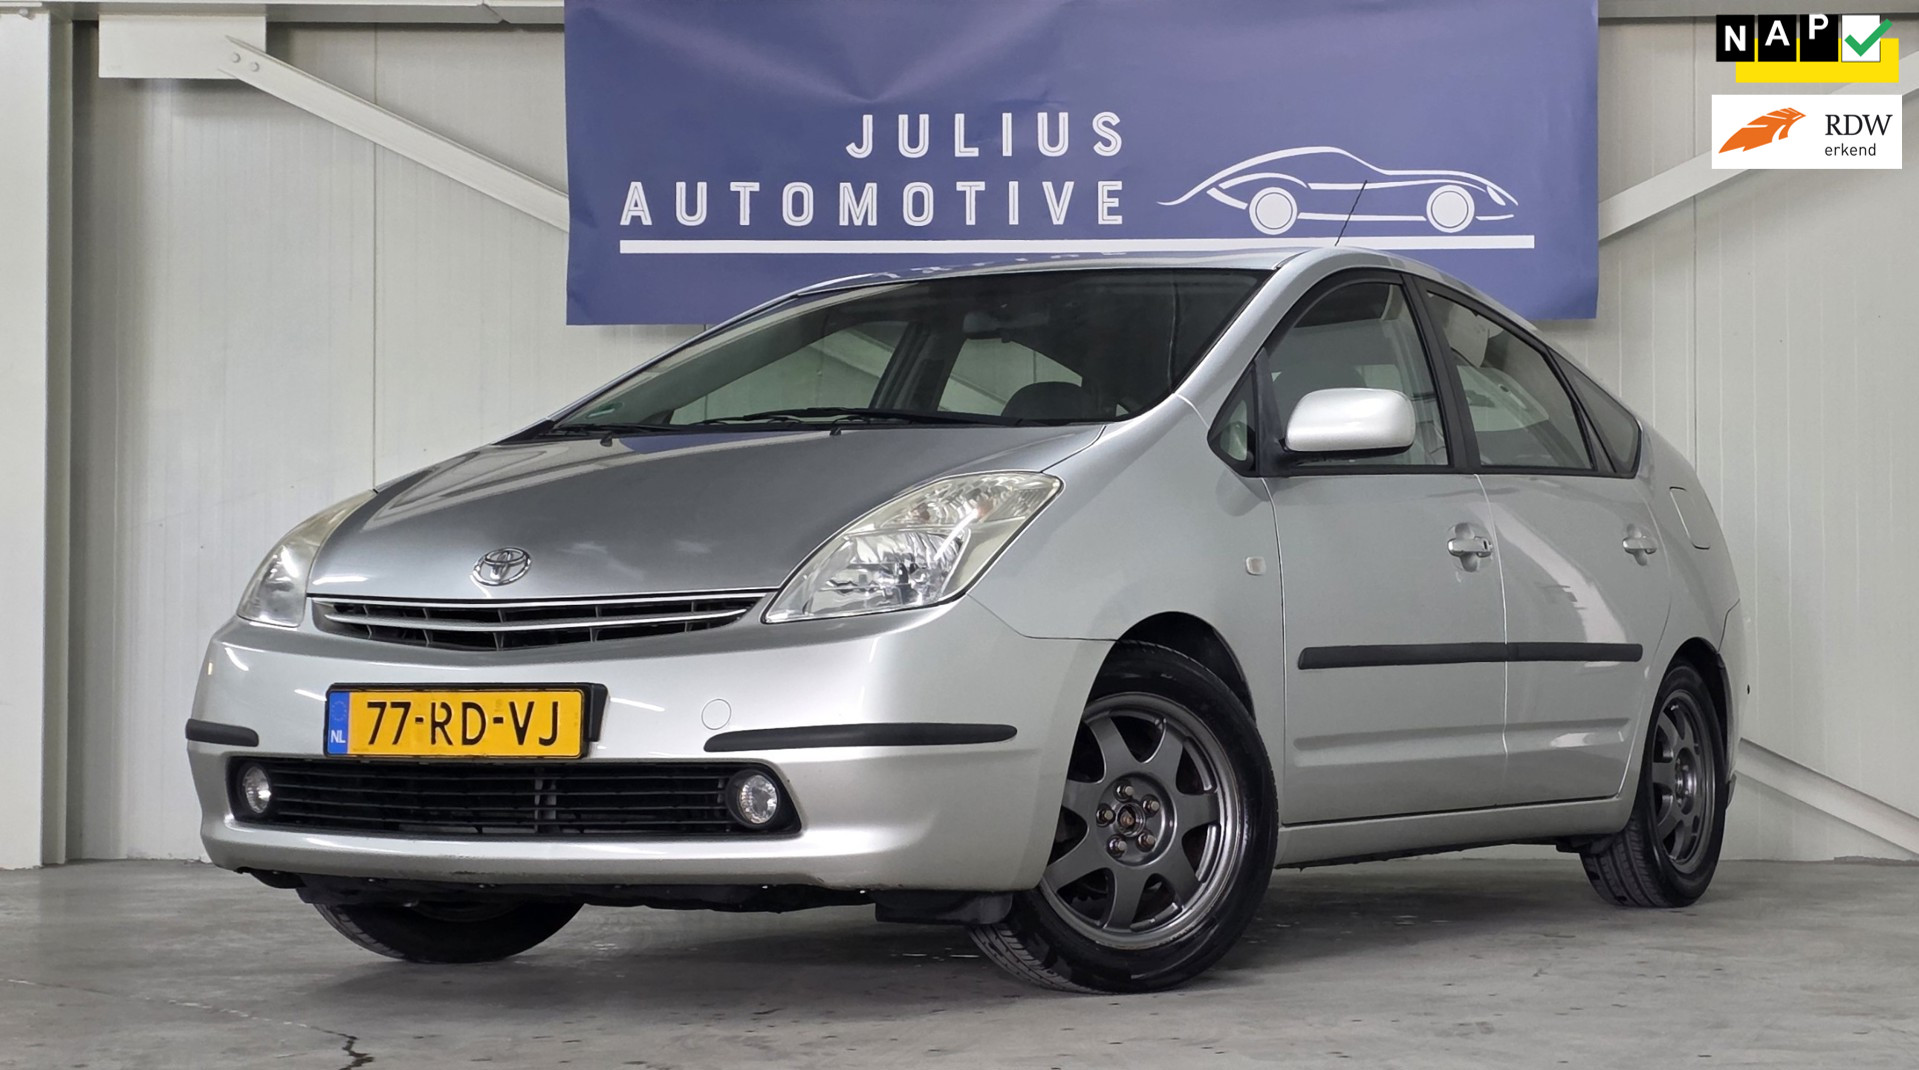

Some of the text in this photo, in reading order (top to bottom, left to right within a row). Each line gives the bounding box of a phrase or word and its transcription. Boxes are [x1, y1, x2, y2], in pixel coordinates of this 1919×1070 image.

[845, 111, 1123, 159] JULIUS
[619, 180, 1123, 227] AUTOMOTIVE
[330, 729, 346, 744] NL
[366, 700, 560, 747] 77-RD-VJ
